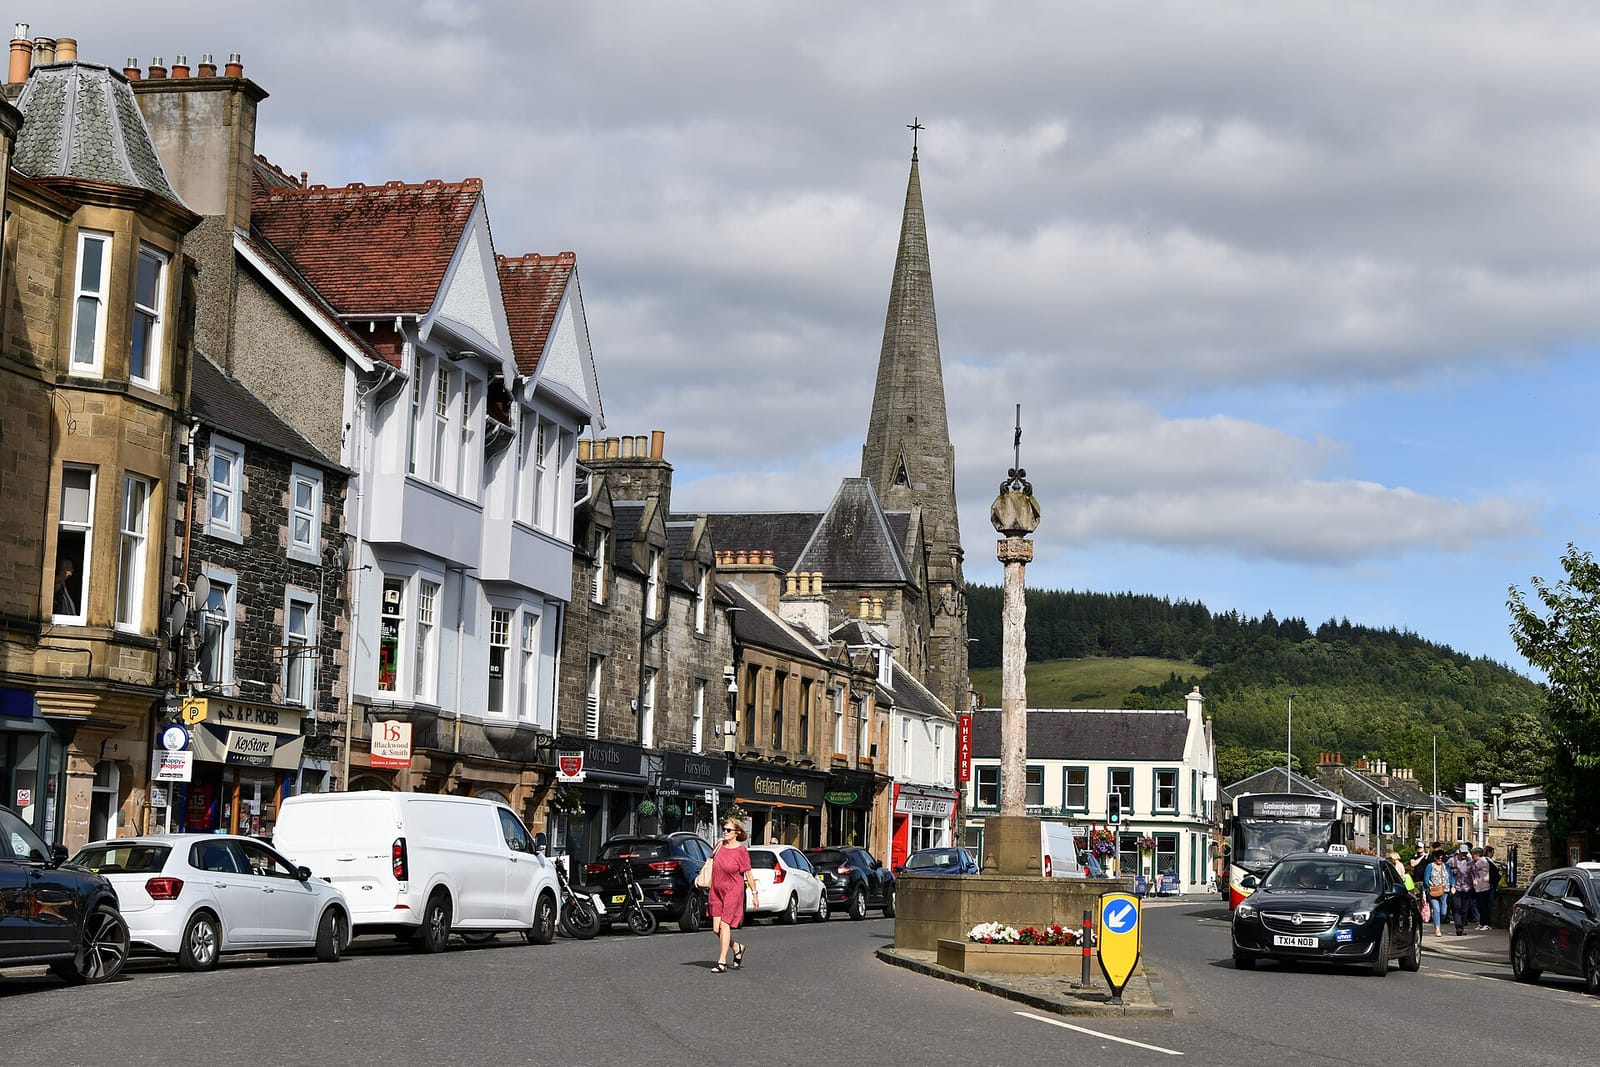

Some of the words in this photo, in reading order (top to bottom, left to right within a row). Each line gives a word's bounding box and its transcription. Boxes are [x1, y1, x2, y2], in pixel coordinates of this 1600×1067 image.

[237, 706, 243, 721] &
[256, 709, 279, 726] ROBB
[235, 736, 270, 753] KeyStore
[374, 741, 409, 749] Blackwood
[588, 744, 620, 766] Forsyths
[684, 758, 711, 778] Forsyths
[656, 788, 679, 797] Forsyths
[755, 775, 780, 795] Graham
[781, 779, 807, 798] McGrath
[1304, 803, 1321, 817] X62
[1278, 936, 1296, 945] TX14
